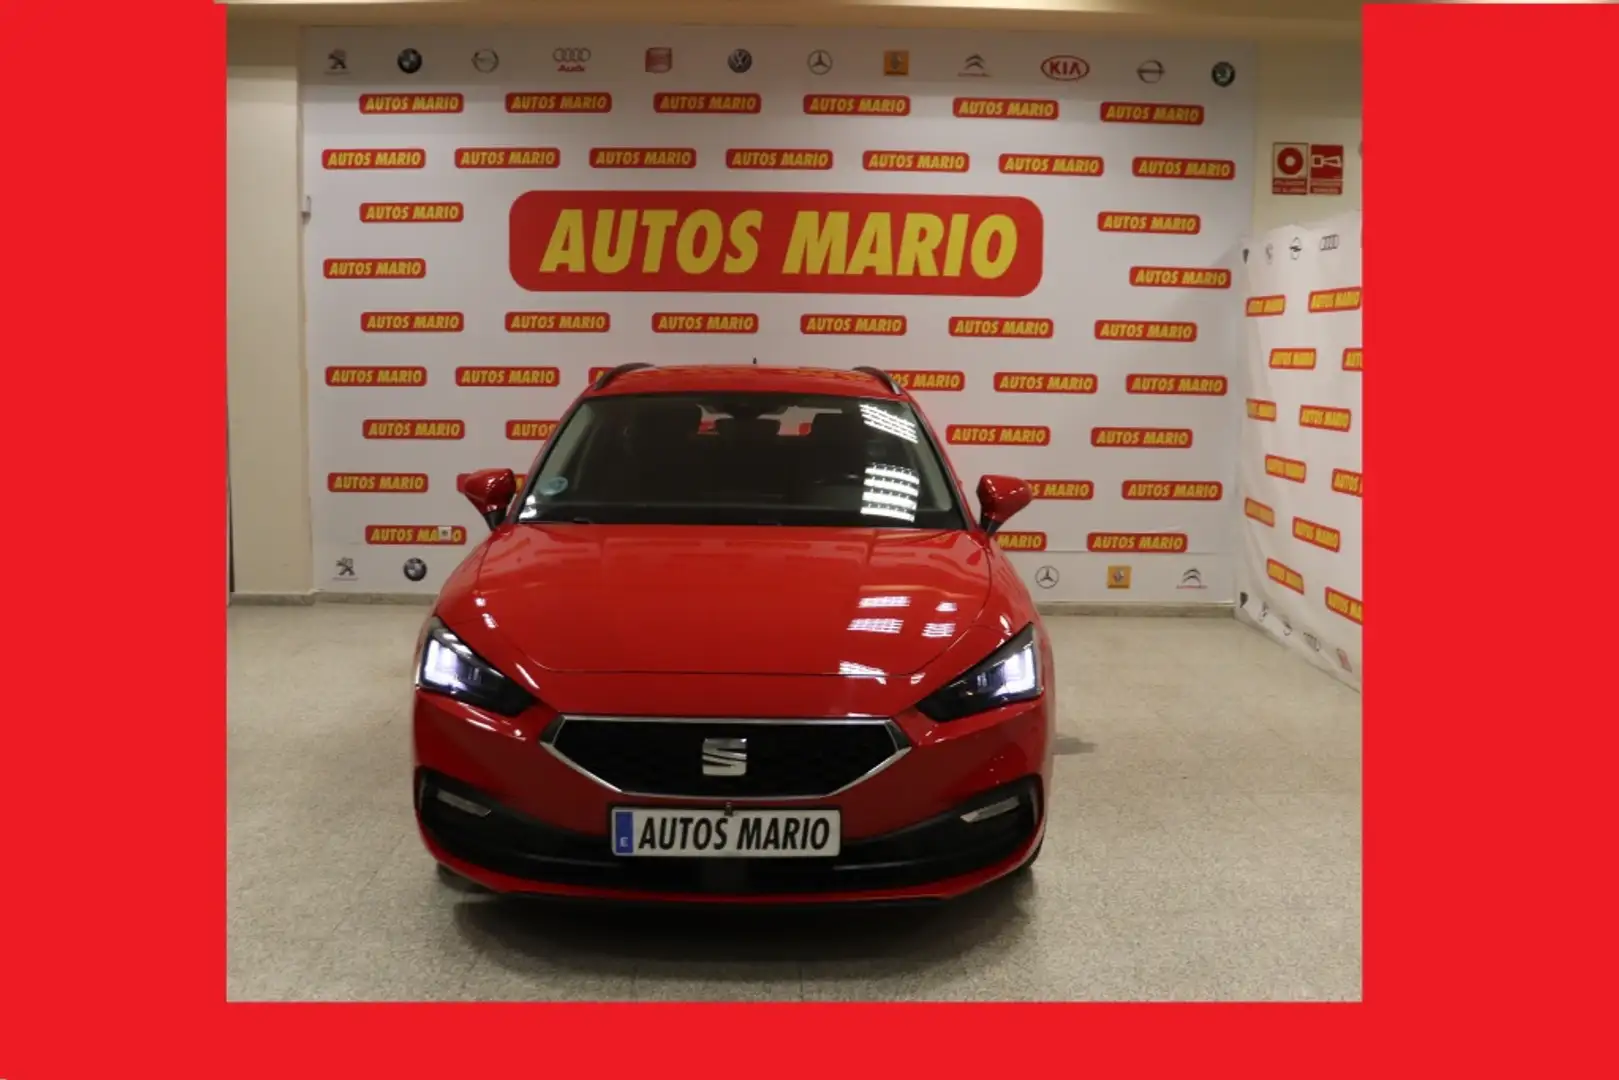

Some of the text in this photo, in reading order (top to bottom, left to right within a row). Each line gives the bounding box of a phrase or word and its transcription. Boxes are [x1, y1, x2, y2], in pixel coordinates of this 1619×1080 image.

[1049, 60, 1082, 76] KIA
[367, 96, 458, 110] AUTOS MARIO
[512, 96, 605, 109] AUTOS MARIO
[661, 96, 756, 110] AUTOS MARIO
[811, 98, 905, 113] AUTOS MARIO
[959, 101, 1054, 117] AUTOS MARIO
[1107, 105, 1199, 122] AUTOS MARIO
[329, 152, 421, 166] AUTOS MARIO
[462, 151, 554, 165] AUTOS MARIO
[596, 151, 691, 165] AUTOS MARIO
[733, 152, 828, 167] AUTOS MARIO
[870, 154, 965, 169] AUTOS MARIO
[1005, 157, 1099, 173] AUTOS MARIO
[1139, 160, 1231, 176] AUTOS MARIO
[366, 206, 458, 219] AUTOS MARIO
[1104, 215, 1196, 231] AUTOS MARIO
[539, 208, 1018, 279] AUTOS MARIO
[330, 262, 421, 276] AUTOS MARIO
[1136, 270, 1226, 286] AUTOS MARIO
[367, 315, 459, 329] AUTOS MARIO
[512, 315, 605, 329] AUTOS MARIO
[659, 316, 753, 330] AUTOS MARIO
[807, 318, 902, 332] AUTOS MARIO
[955, 320, 1048, 336] AUTOS MARIO
[1101, 323, 1192, 338] AUTOS MARIO
[331, 369, 422, 383] AUTOS MARIO
[462, 369, 555, 383] AUTOS MARIO
[914, 374, 960, 388] MARIO
[1000, 375, 1093, 390] AUTOS MARIO
[1132, 378, 1223, 392] AUTOS MARIO
[369, 423, 460, 436] AUTOS MARIO
[952, 428, 1045, 443] AUTOS MARIO
[1097, 431, 1188, 446] AUTOS MARIO
[335, 476, 424, 490] AUTOS MARIO
[1128, 483, 1218, 497] AUTOS MARIO
[1044, 484, 1089, 498] MARIO
[371, 529, 461, 542] AUTOS MAO
[998, 535, 1042, 548] MARIO
[1094, 536, 1183, 550] AUTOS MARIO
[620, 817, 830, 851] E AUTOS MARIO
